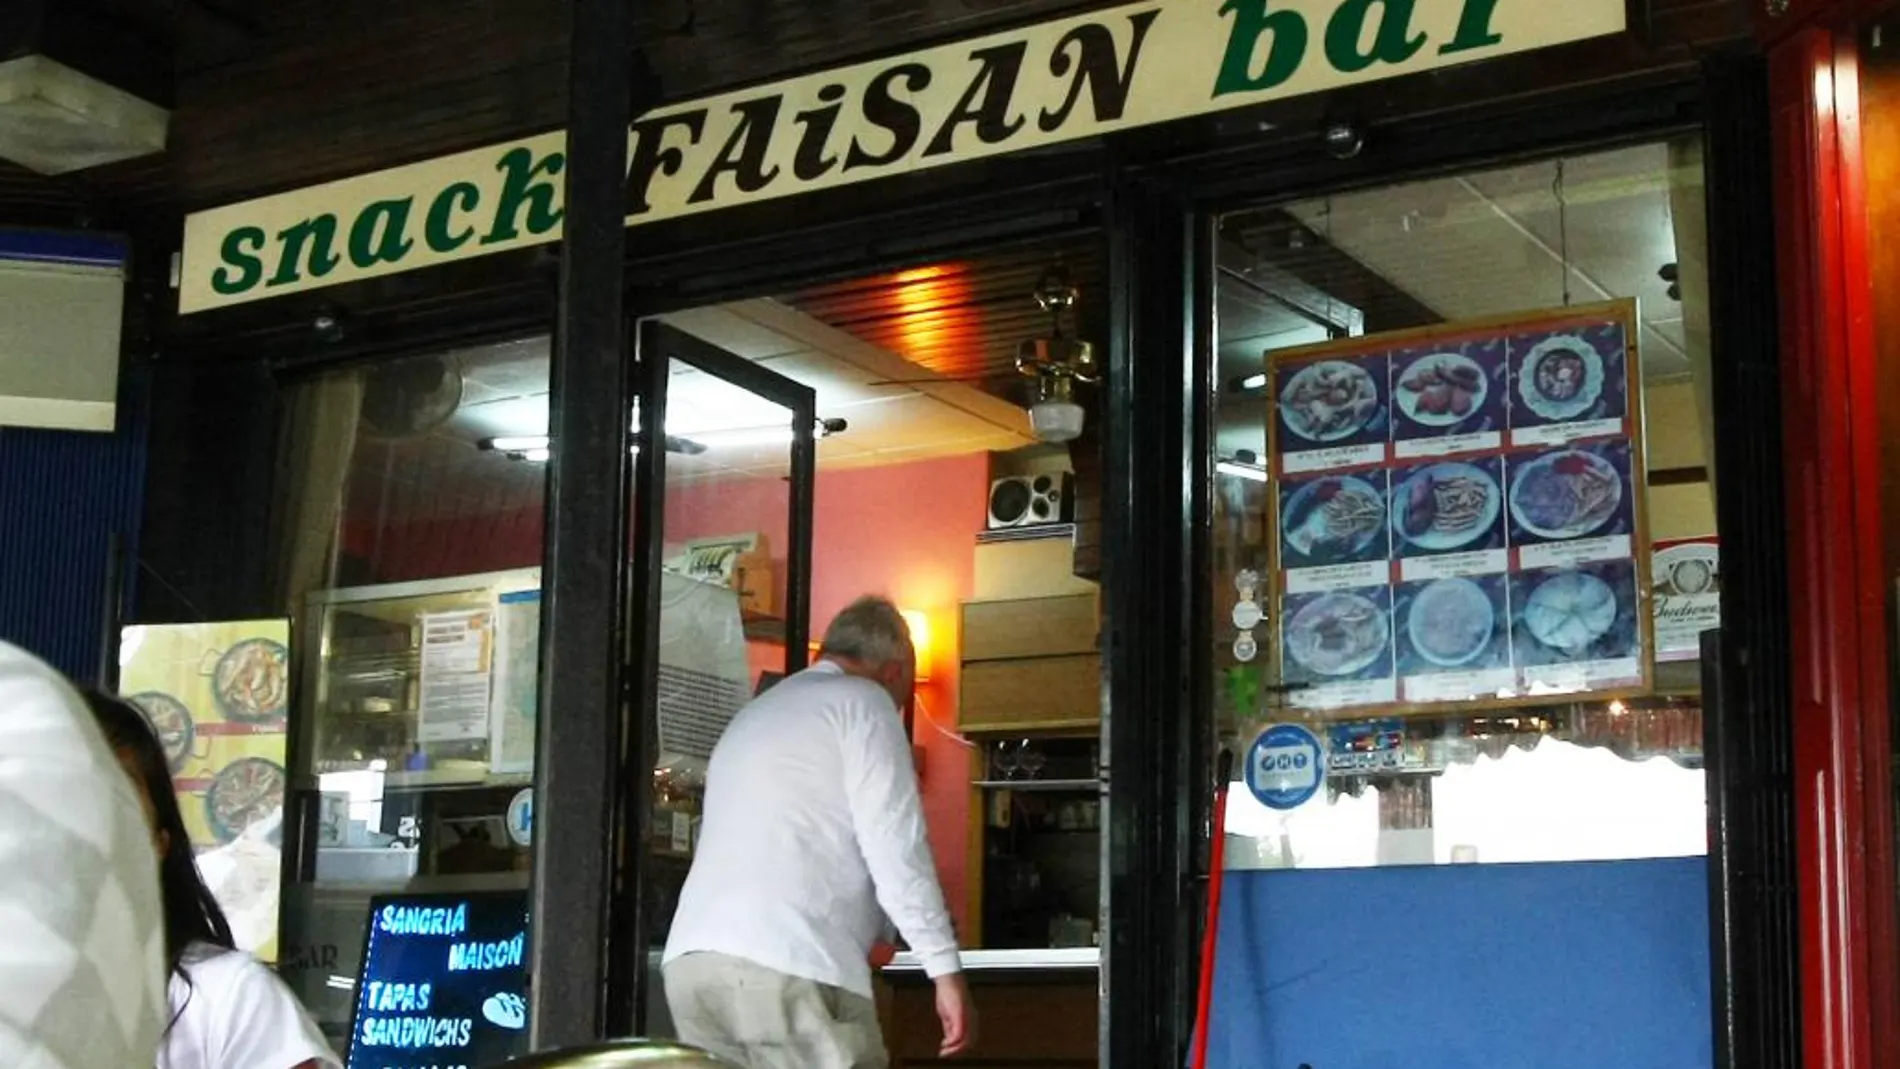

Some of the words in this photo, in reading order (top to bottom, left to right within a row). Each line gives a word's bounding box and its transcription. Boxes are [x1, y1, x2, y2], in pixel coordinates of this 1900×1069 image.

[212, 147, 564, 295] snack
[1211, 0, 1503, 100] bar
[380, 903, 466, 935] SANGRIA
[448, 932, 524, 971] MAISON
[368, 981, 432, 1012] TAPAS
[361, 1017, 472, 1048] SANDWICHS
